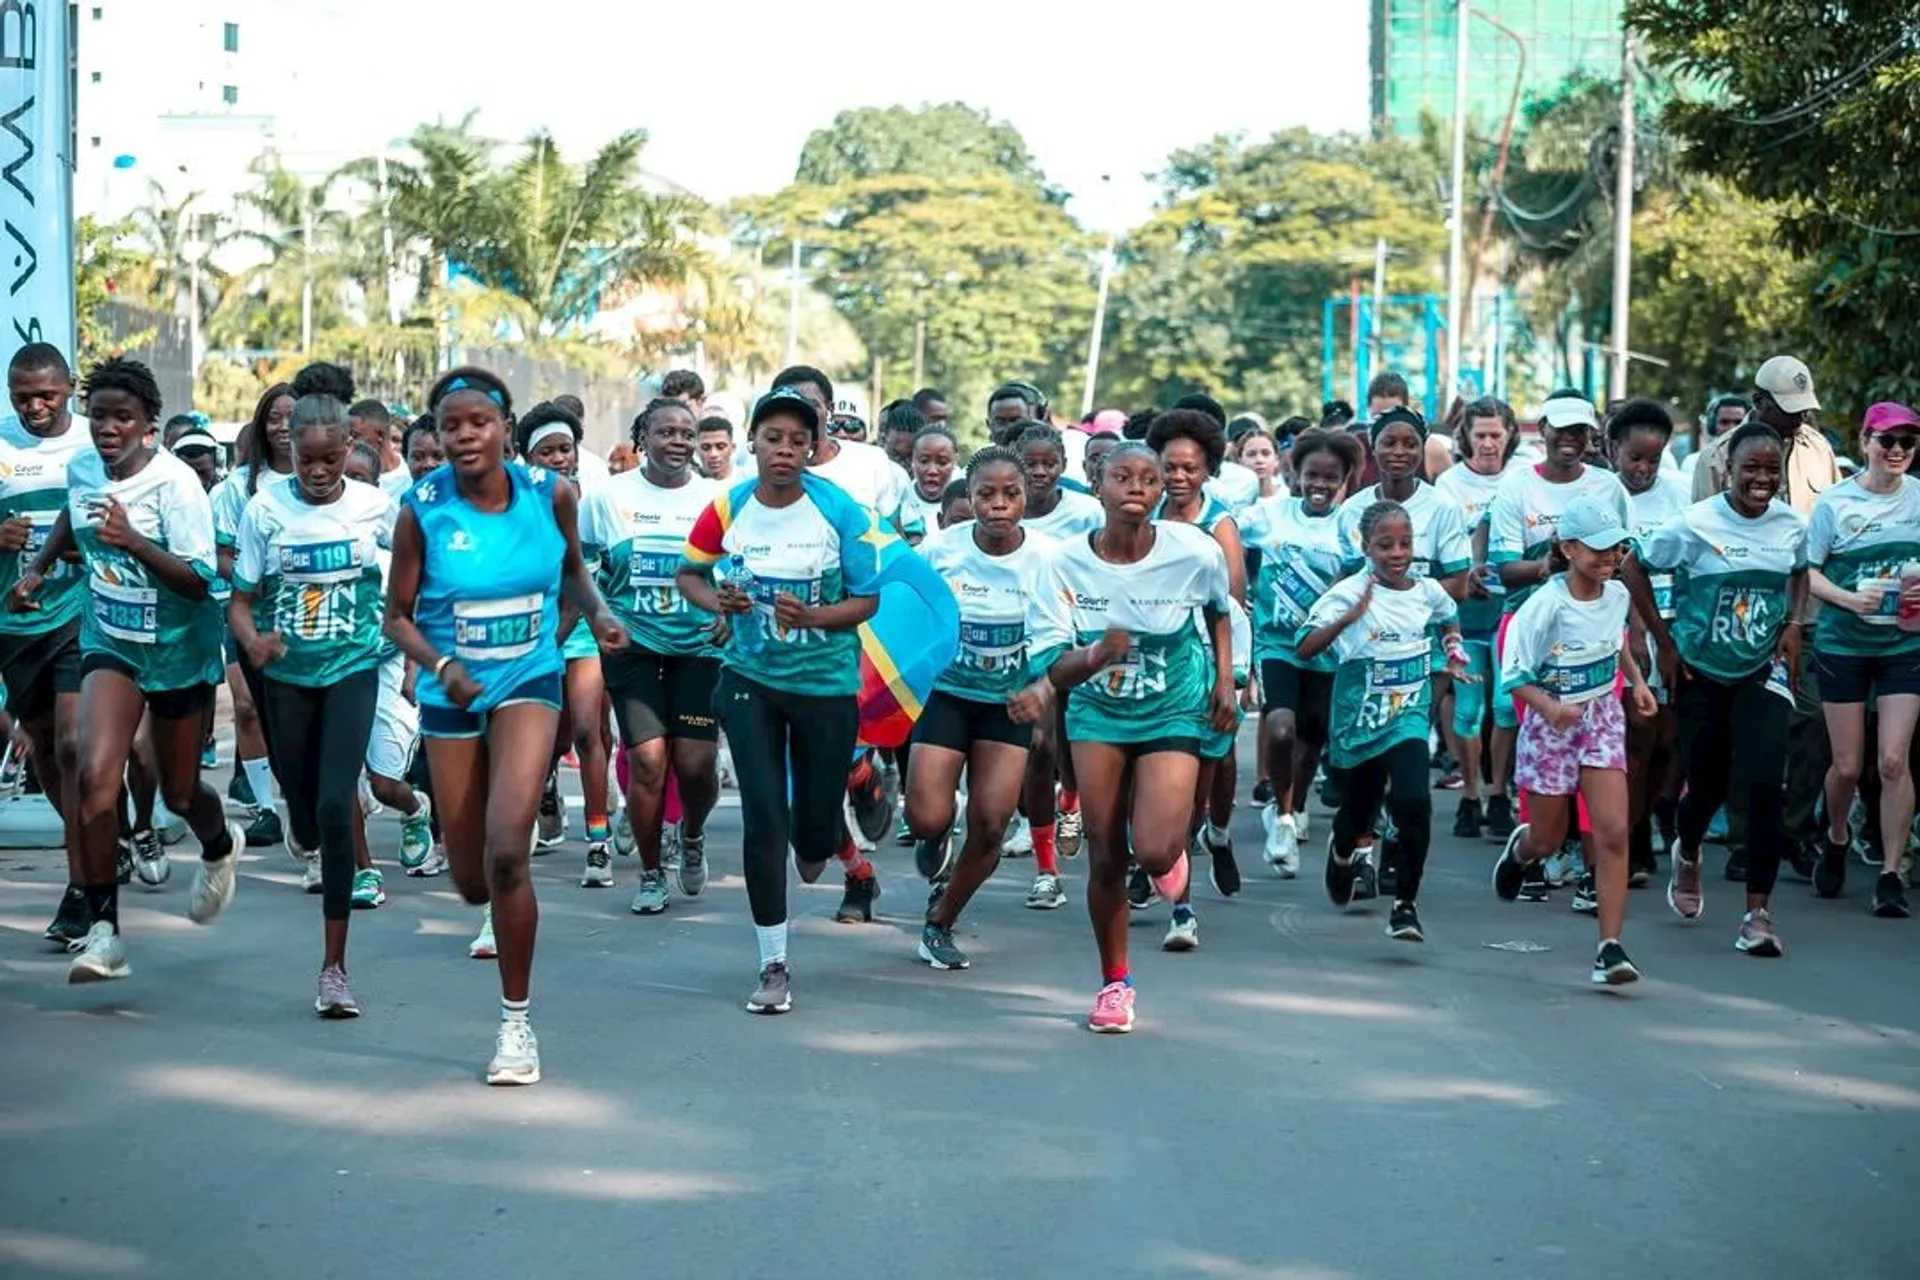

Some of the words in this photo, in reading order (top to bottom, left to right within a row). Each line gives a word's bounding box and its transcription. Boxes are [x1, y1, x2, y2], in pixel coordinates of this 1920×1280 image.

[312, 545, 347, 570] 119
[657, 556, 684, 575] 14
[1075, 594, 1109, 606] Courir
[109, 606, 143, 629] 133
[487, 615, 530, 645] 132
[991, 626, 1022, 645] 157
